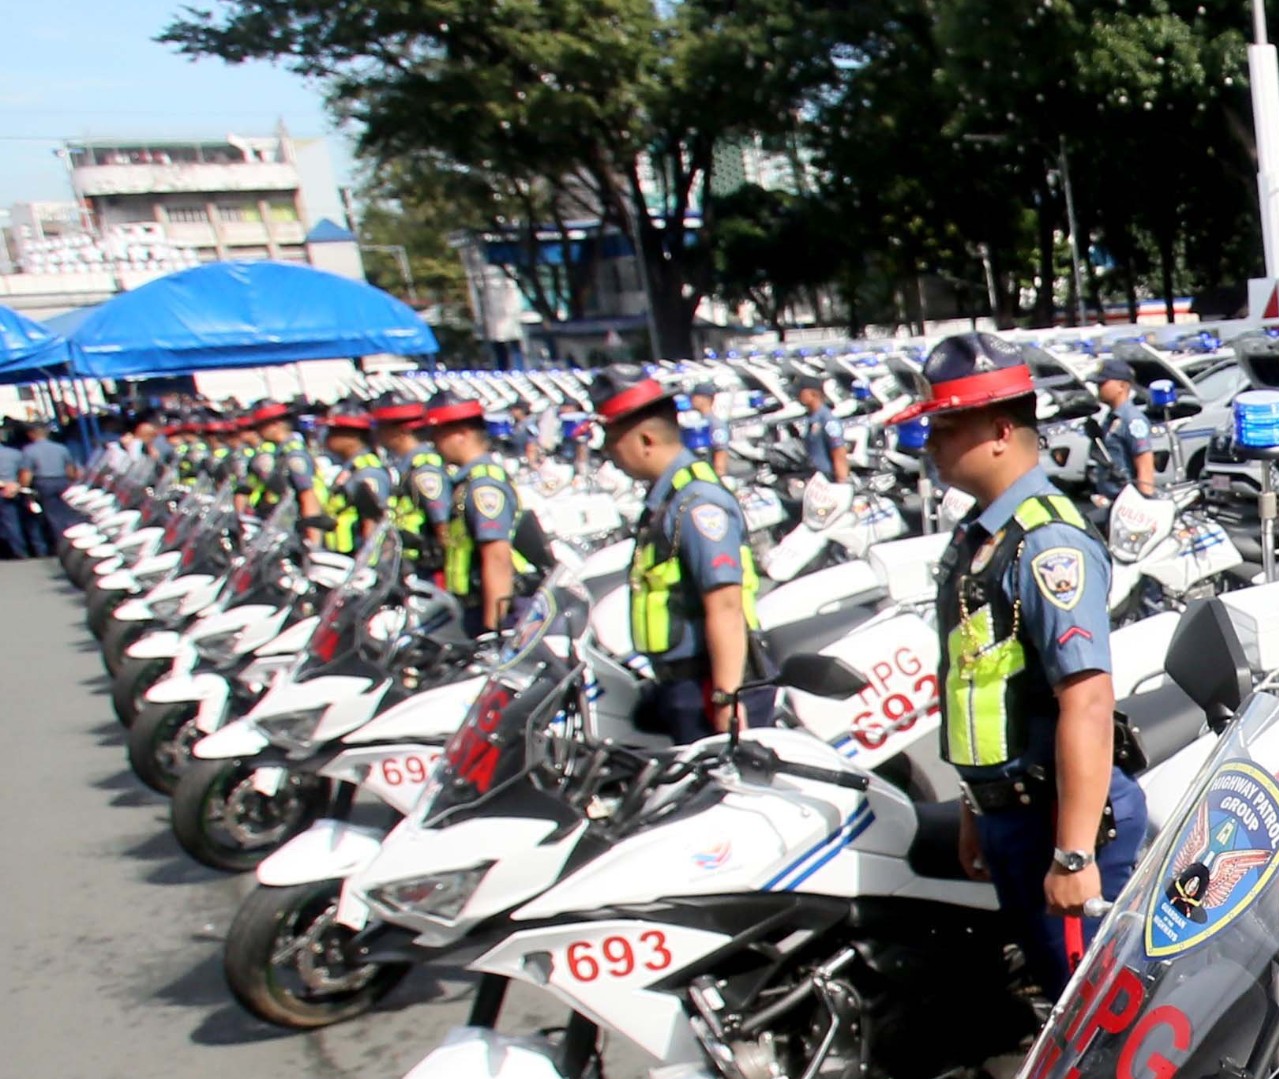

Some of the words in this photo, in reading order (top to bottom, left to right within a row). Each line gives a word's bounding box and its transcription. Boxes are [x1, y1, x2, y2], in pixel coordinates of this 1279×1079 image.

[857, 647, 922, 706] HPG
[852, 674, 940, 750] 692
[382, 754, 440, 786] 69
[1211, 775, 1258, 800] HIGHWAY
[1220, 796, 1260, 831] GROUP
[567, 930, 672, 982] 693
